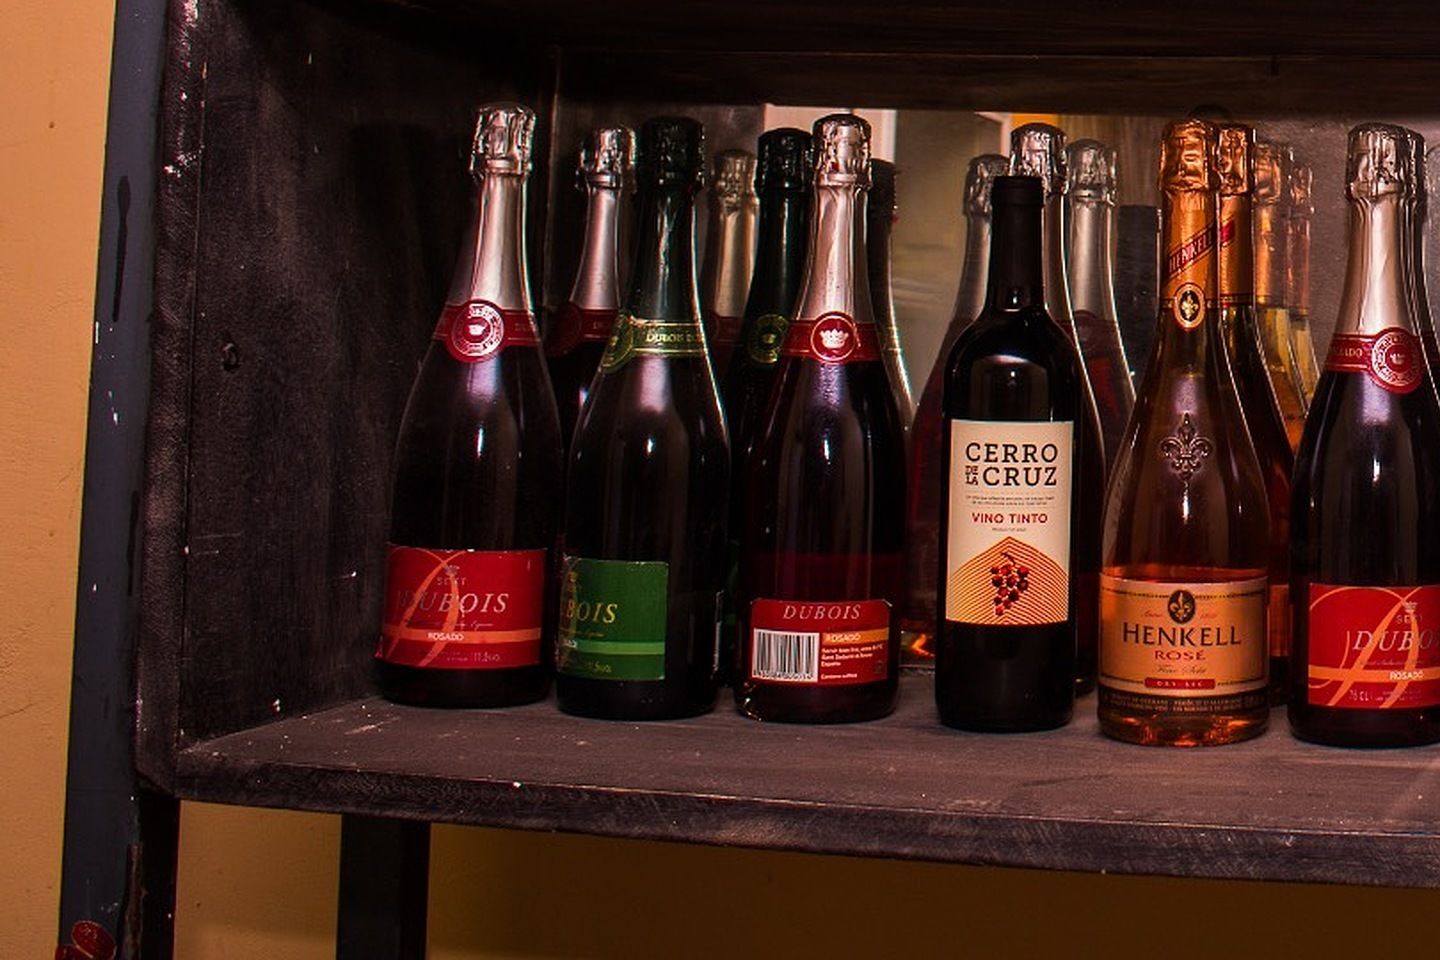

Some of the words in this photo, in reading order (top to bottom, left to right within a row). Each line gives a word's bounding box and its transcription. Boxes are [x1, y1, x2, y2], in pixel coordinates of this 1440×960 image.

[966, 442, 1058, 464] CERRO
[965, 465, 979, 476] DE
[965, 476, 979, 486] LA
[982, 466, 1058, 487] CRUZ
[971, 512, 1004, 524] VINO
[1009, 512, 1048, 524] TINTO
[782, 603, 861, 619] DUBOIS
[428, 631, 465, 641] ROSADO
[1123, 622, 1242, 647] HENKELL
[1154, 649, 1207, 661] ROSÉ
[1389, 670, 1424, 681] ROSADO
